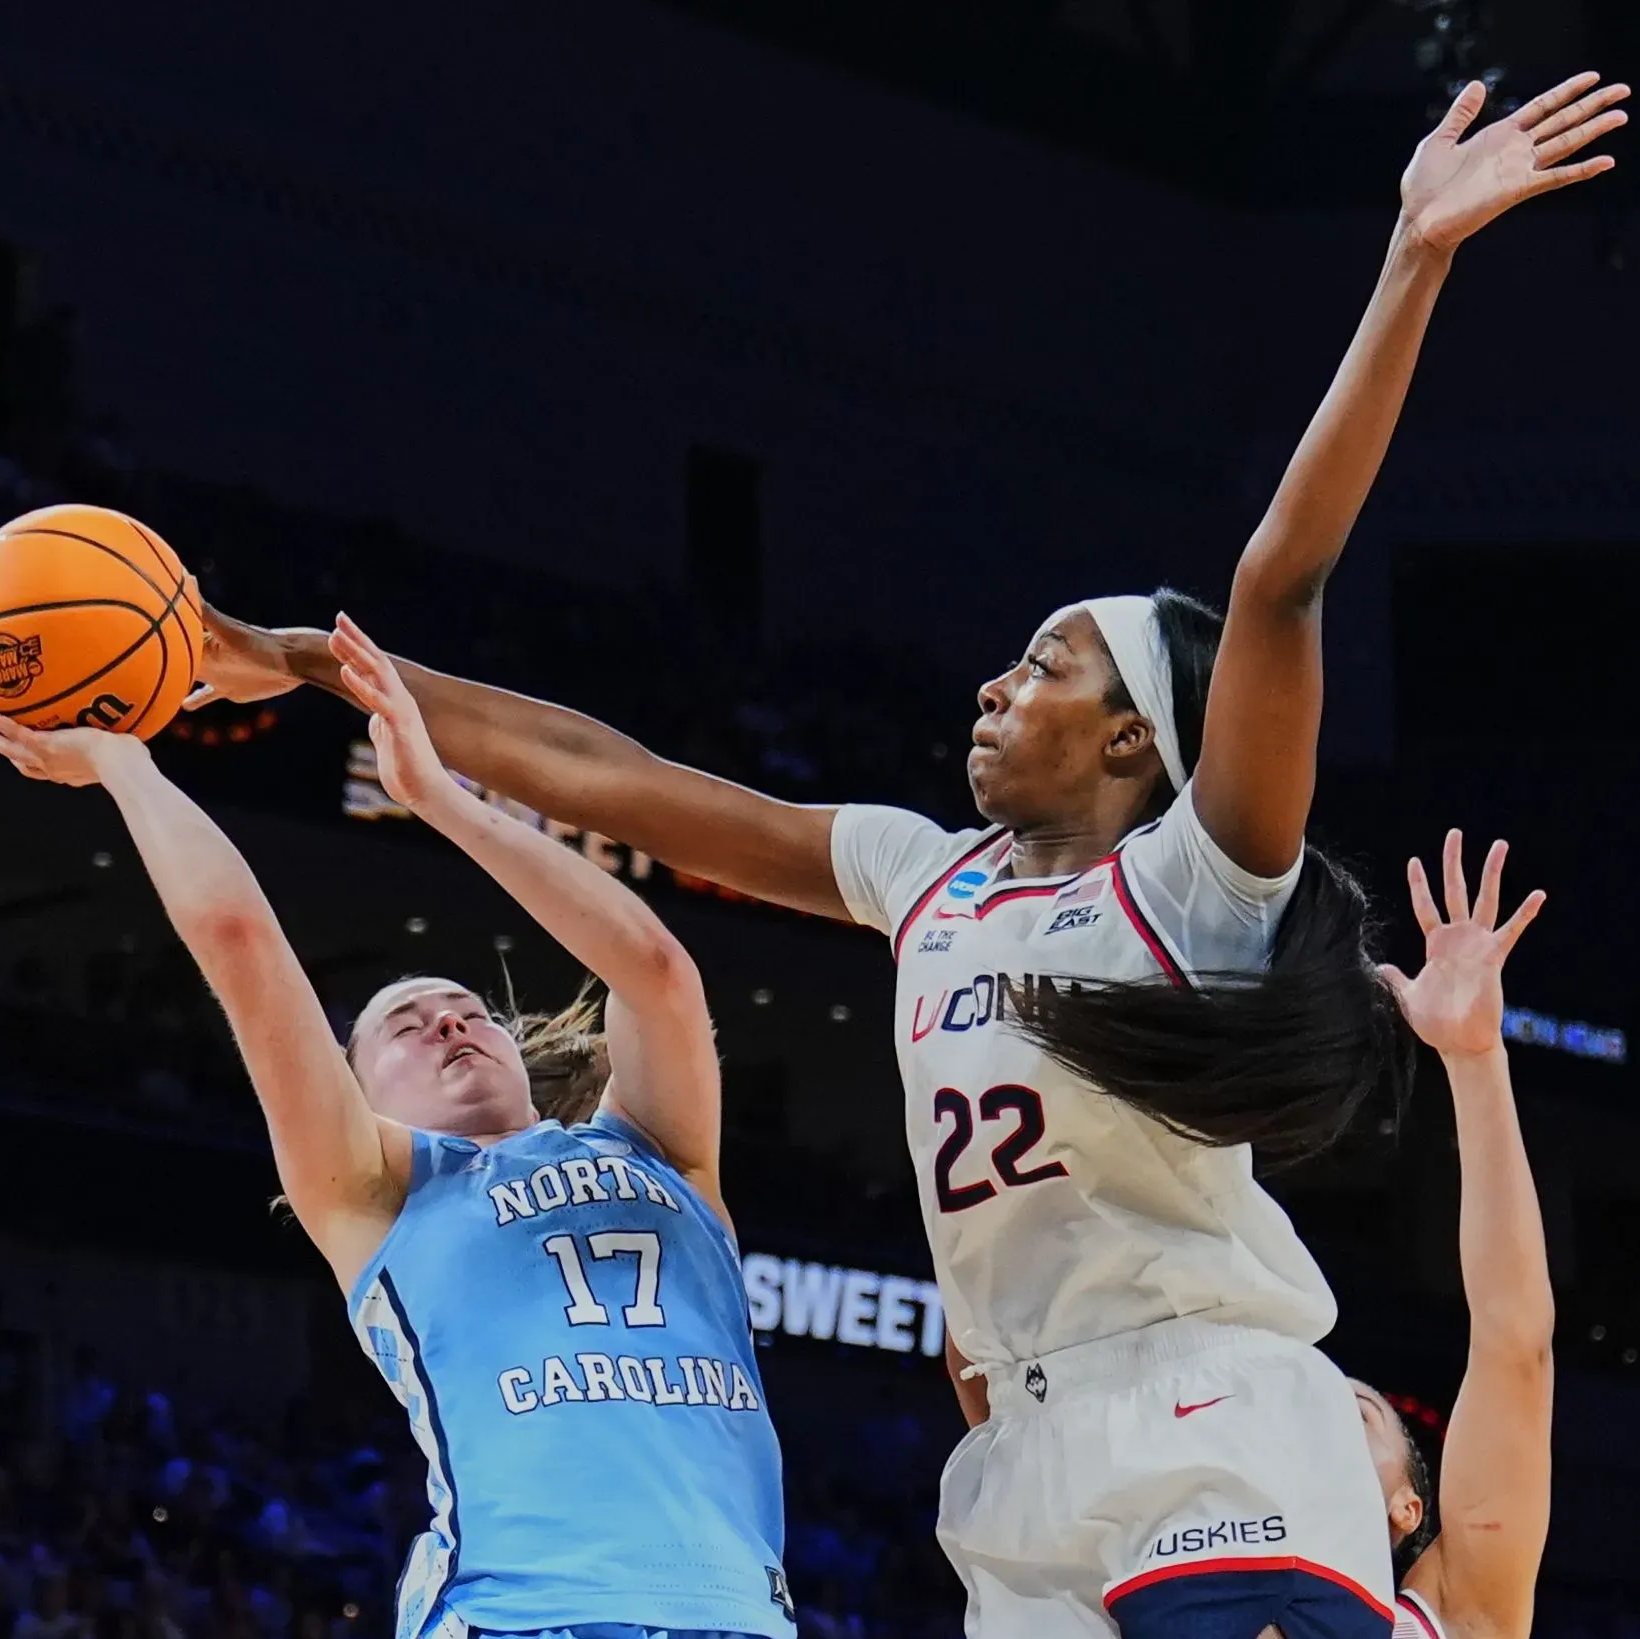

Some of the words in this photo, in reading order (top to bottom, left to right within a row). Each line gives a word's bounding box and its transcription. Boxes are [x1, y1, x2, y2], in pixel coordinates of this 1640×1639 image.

[1048, 914, 1104, 931] EAST
[1057, 905, 1095, 921] BIG
[933, 1083, 1070, 1214] 22
[488, 1155, 681, 1227] NORTH
[545, 1229, 667, 1329] 17
[742, 1251, 946, 1359] SWEET
[497, 1352, 760, 1416] CAROLINA
[1147, 1515, 1289, 1559] USKIES
